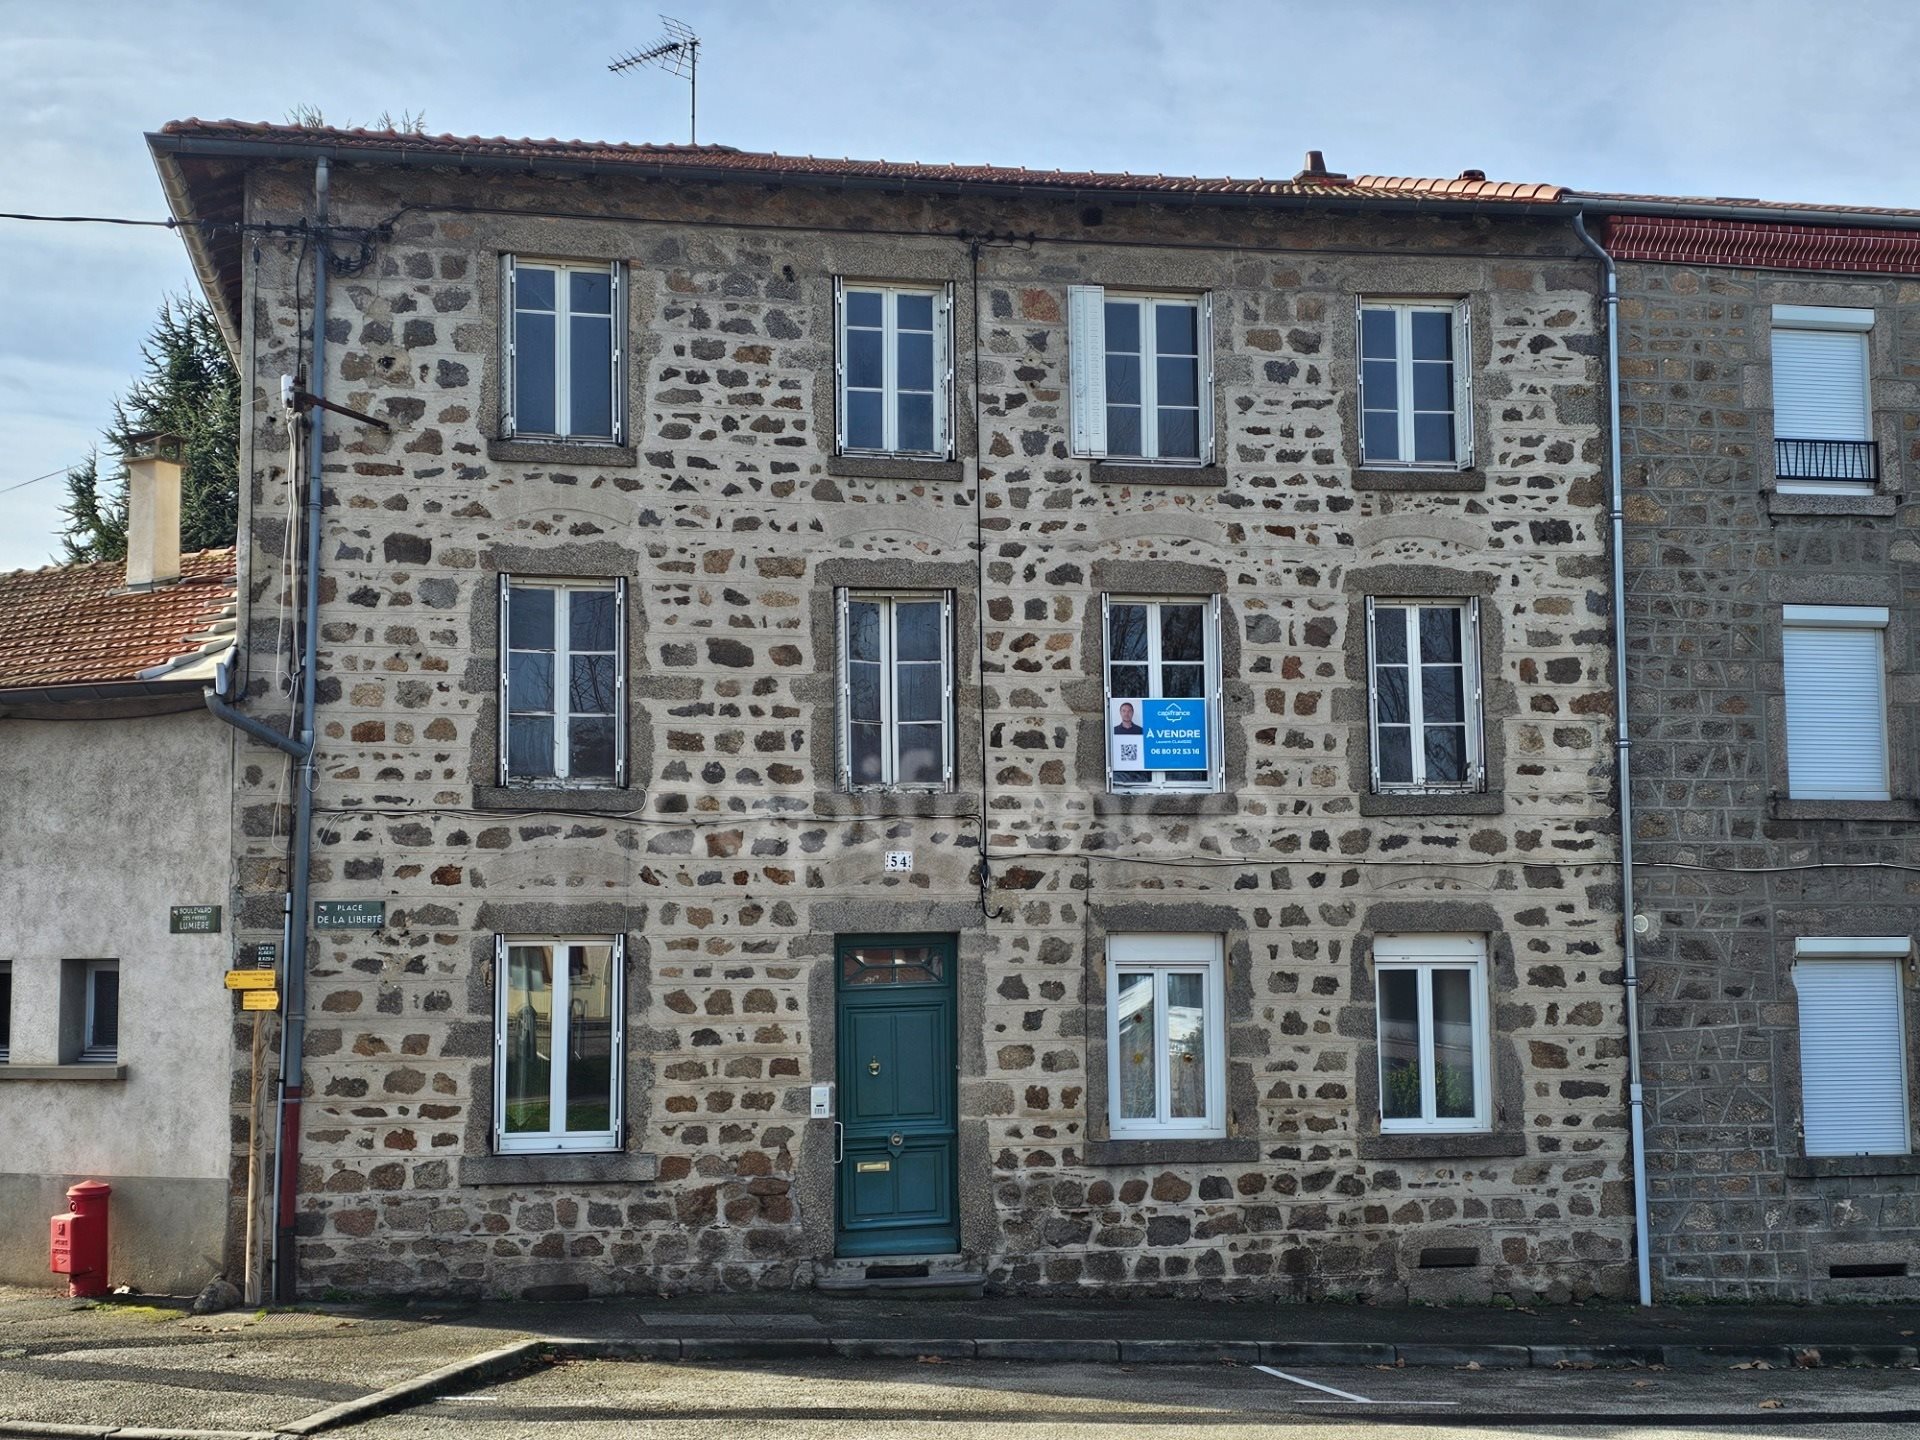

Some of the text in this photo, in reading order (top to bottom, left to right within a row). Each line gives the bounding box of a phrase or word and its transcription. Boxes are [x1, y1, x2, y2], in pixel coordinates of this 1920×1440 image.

[1146, 728, 1200, 738] À VENDRE
[890, 855, 907, 867] 54
[317, 914, 382, 924] DE LA LIBERTÉ
